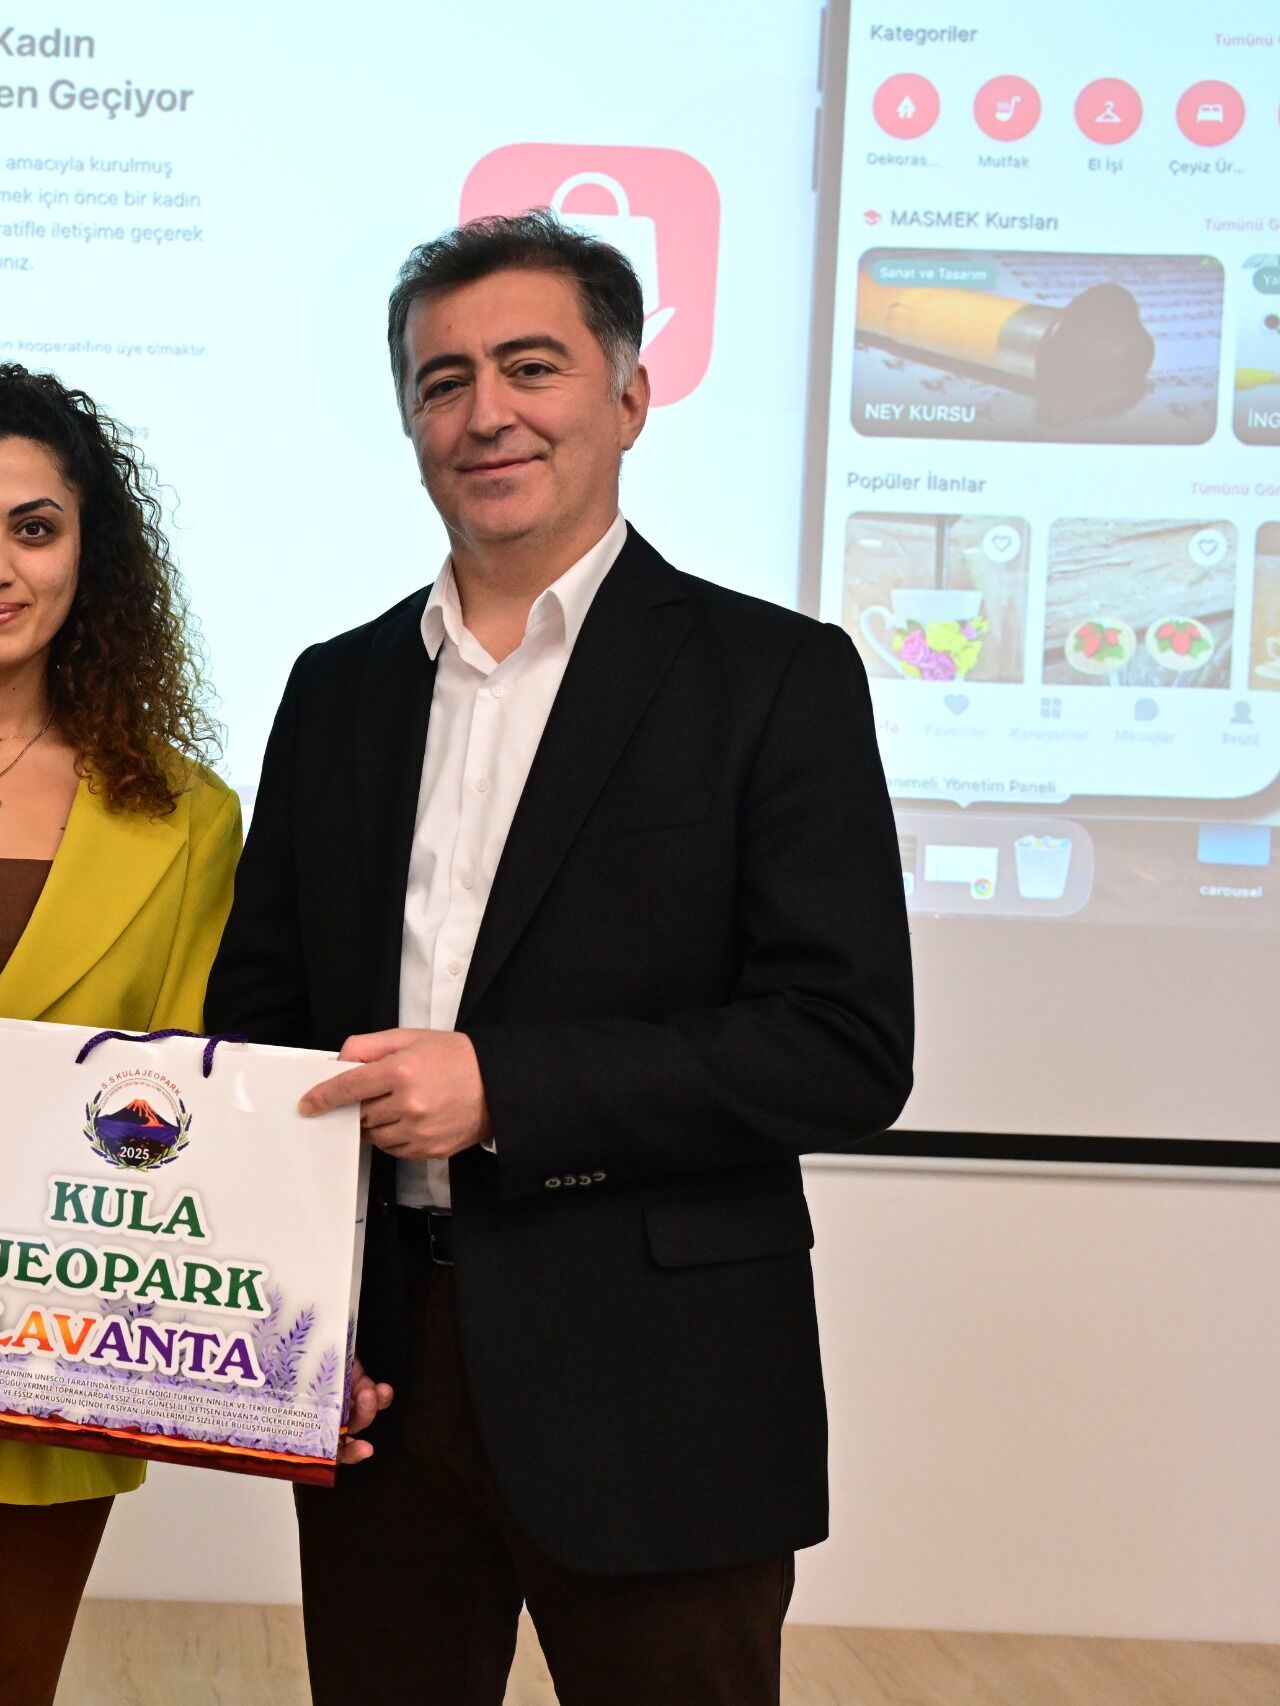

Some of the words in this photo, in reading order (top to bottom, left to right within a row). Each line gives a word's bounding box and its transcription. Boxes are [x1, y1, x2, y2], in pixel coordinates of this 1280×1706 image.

[870, 25, 978, 45] Kategoriler
[49, 79, 194, 120] Geçiyor
[6, 156, 84, 176] amacıyla
[90, 156, 173, 178] kurulmuş
[978, 154, 1029, 169] Mutfak
[1088, 158, 1102, 171] El
[1105, 157, 1123, 175] İşi
[1168, 159, 1210, 175] Çeyiz
[38, 188, 68, 208] için
[75, 188, 118, 206] önce
[124, 190, 147, 206] bir
[153, 191, 200, 208] kadın
[891, 209, 980, 228] MASMEK
[985, 211, 1059, 231] Kursları
[1206, 217, 1264, 232] Tümünü
[51, 221, 124, 243] iletişime
[130, 225, 204, 245] geçerek
[880, 266, 915, 279] Sanat
[919, 269, 934, 279] ve
[18, 338, 112, 354] kooperatifine
[865, 403, 904, 420] NEY
[909, 405, 976, 423] KURSU
[847, 471, 921, 493] Popüler
[927, 470, 986, 493] İlanlar
[943, 776, 1004, 793] Yönetim
[1009, 779, 1056, 795] Paneli
[1200, 884, 1263, 898] carousel
[141, 1069, 183, 1097] JEOPARK
[119, 1146, 150, 1160] 2025
[50, 1181, 205, 1238] KULA
[2, 1388, 12, 1396] VE
[33, 1372, 65, 1384] UNESCO
[66, 1377, 115, 1391] TARAFINDAN
[236, 1401, 246, 1410] VE
[248, 1403, 262, 1412] TEK
[262, 1405, 318, 1420] JEOPARKINDA
[54, 1385, 109, 1400] TOPRAKLARDA
[131, 1396, 145, 1405] EGE
[221, 1409, 259, 1421] LAVANTA
